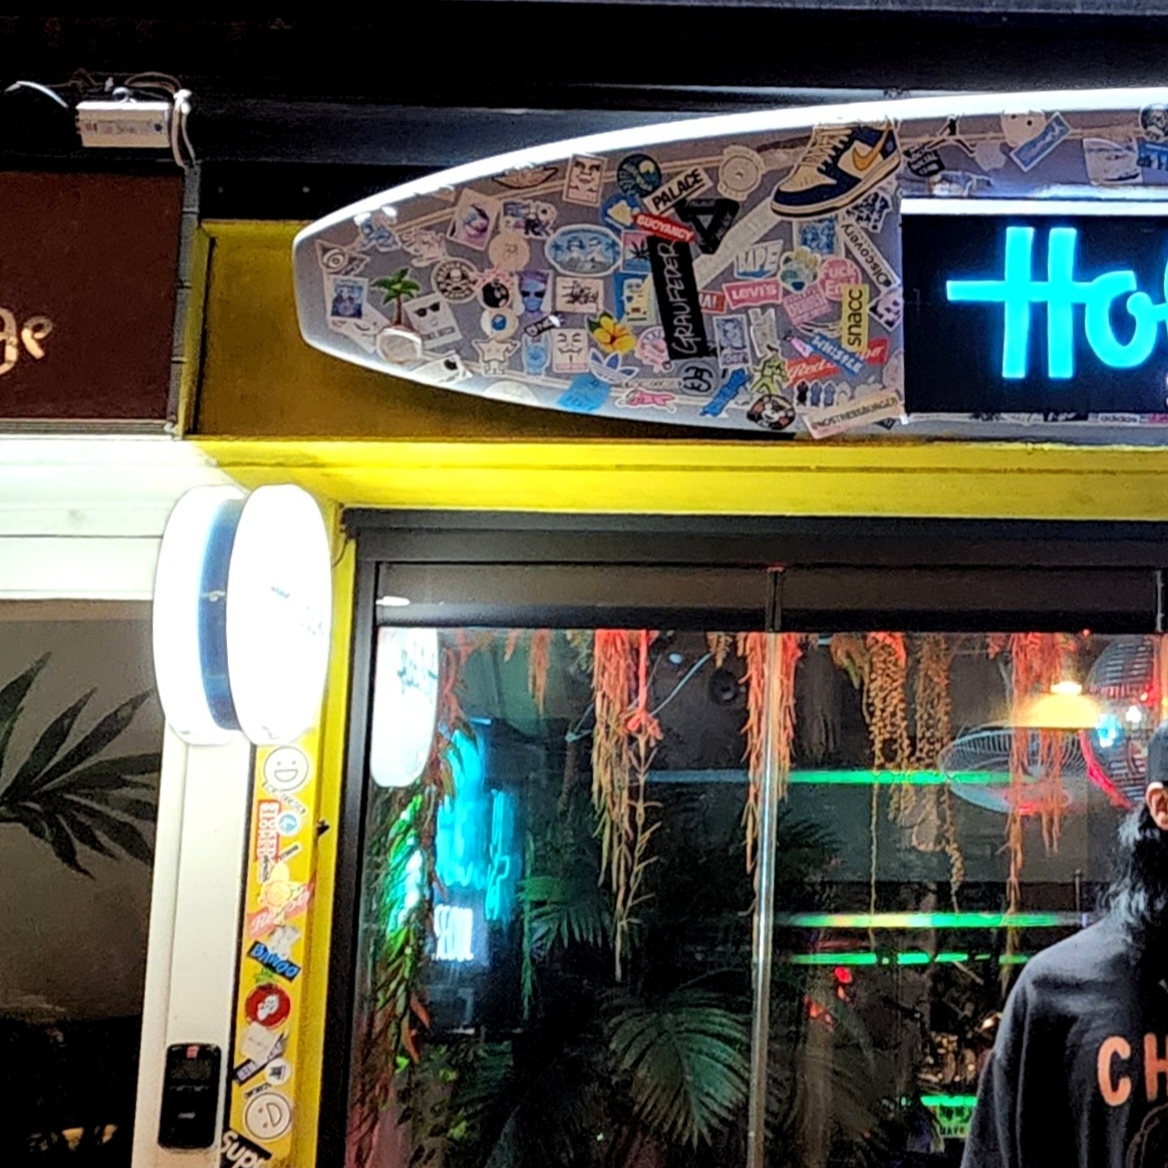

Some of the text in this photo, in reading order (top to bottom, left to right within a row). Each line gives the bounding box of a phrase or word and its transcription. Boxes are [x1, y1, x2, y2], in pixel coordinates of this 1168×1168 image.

[651, 167, 703, 212] PALACE
[636, 216, 694, 242] BUOYANCY
[841, 222, 885, 288] Discovery
[847, 288, 862, 348] snacc
